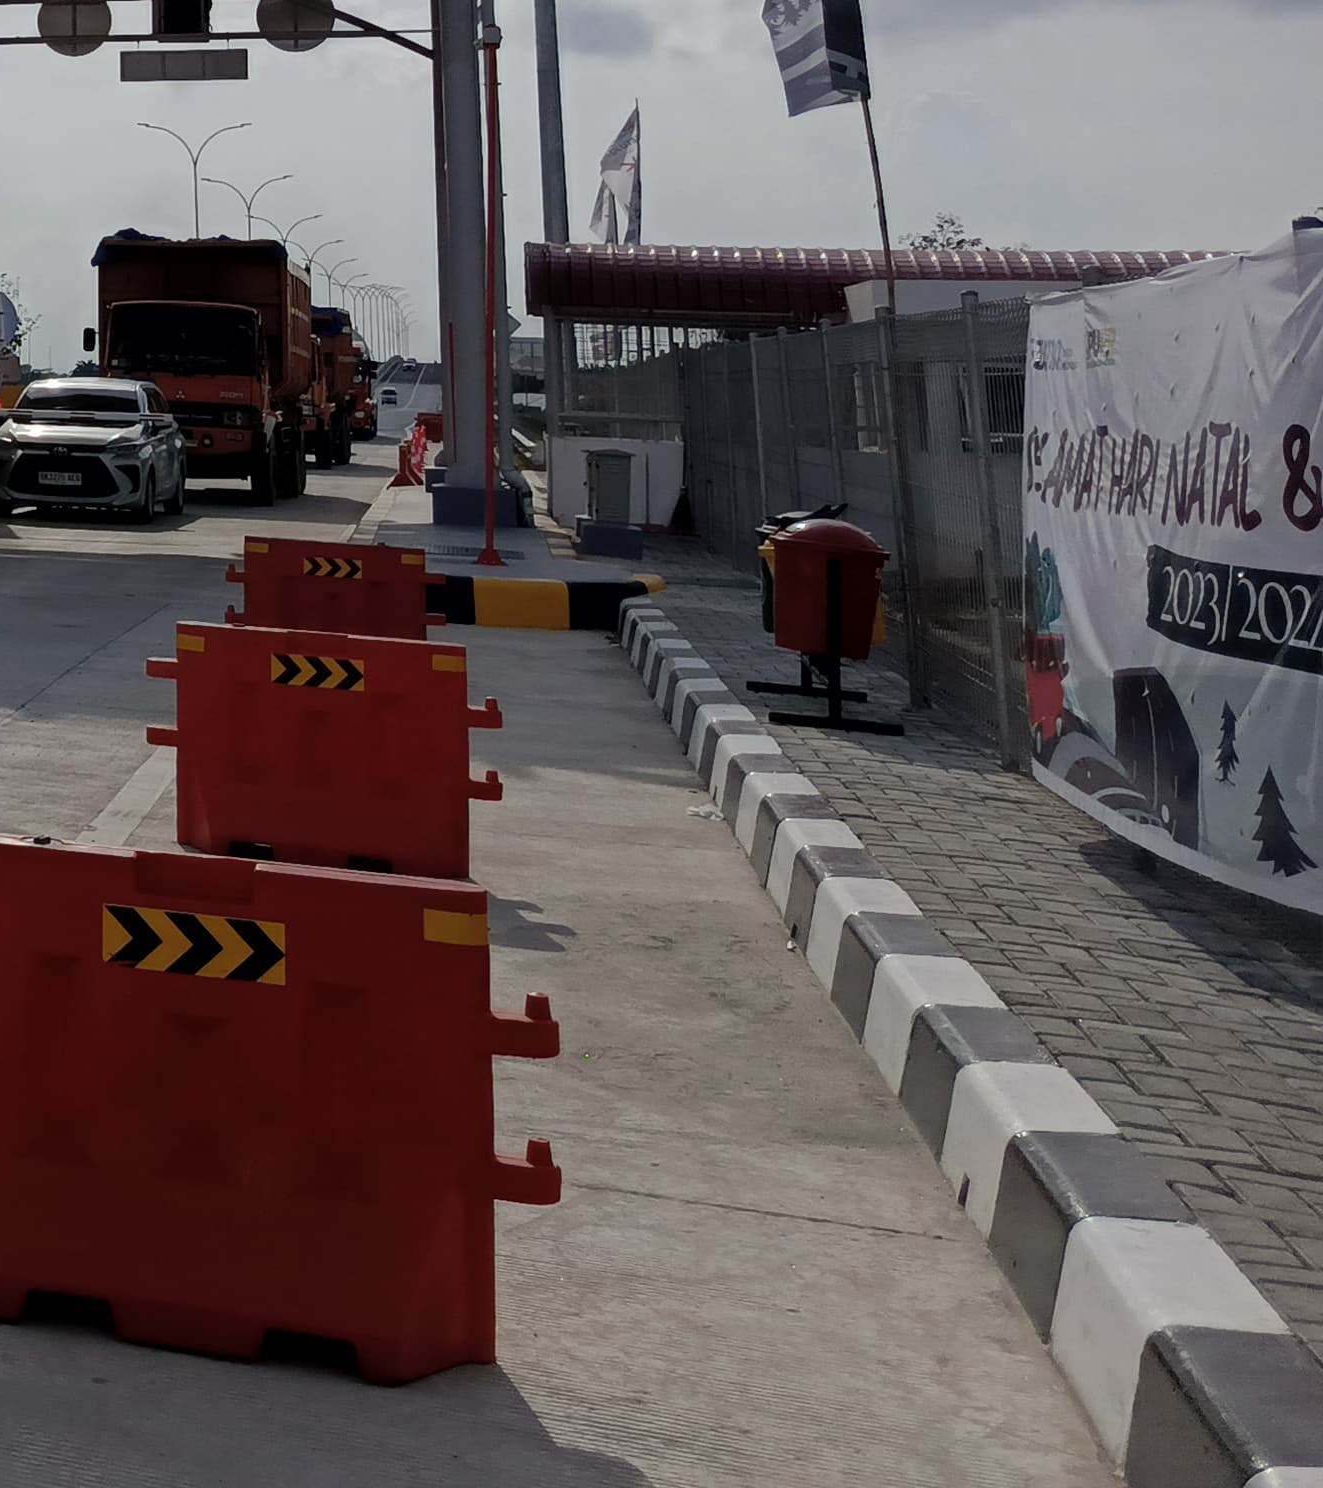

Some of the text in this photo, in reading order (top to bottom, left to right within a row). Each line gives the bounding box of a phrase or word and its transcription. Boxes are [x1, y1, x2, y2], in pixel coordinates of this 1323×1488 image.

[1108, 427, 1161, 516] HARI
[1161, 420, 1262, 532] NATAL
[1282, 423, 1323, 532] &
